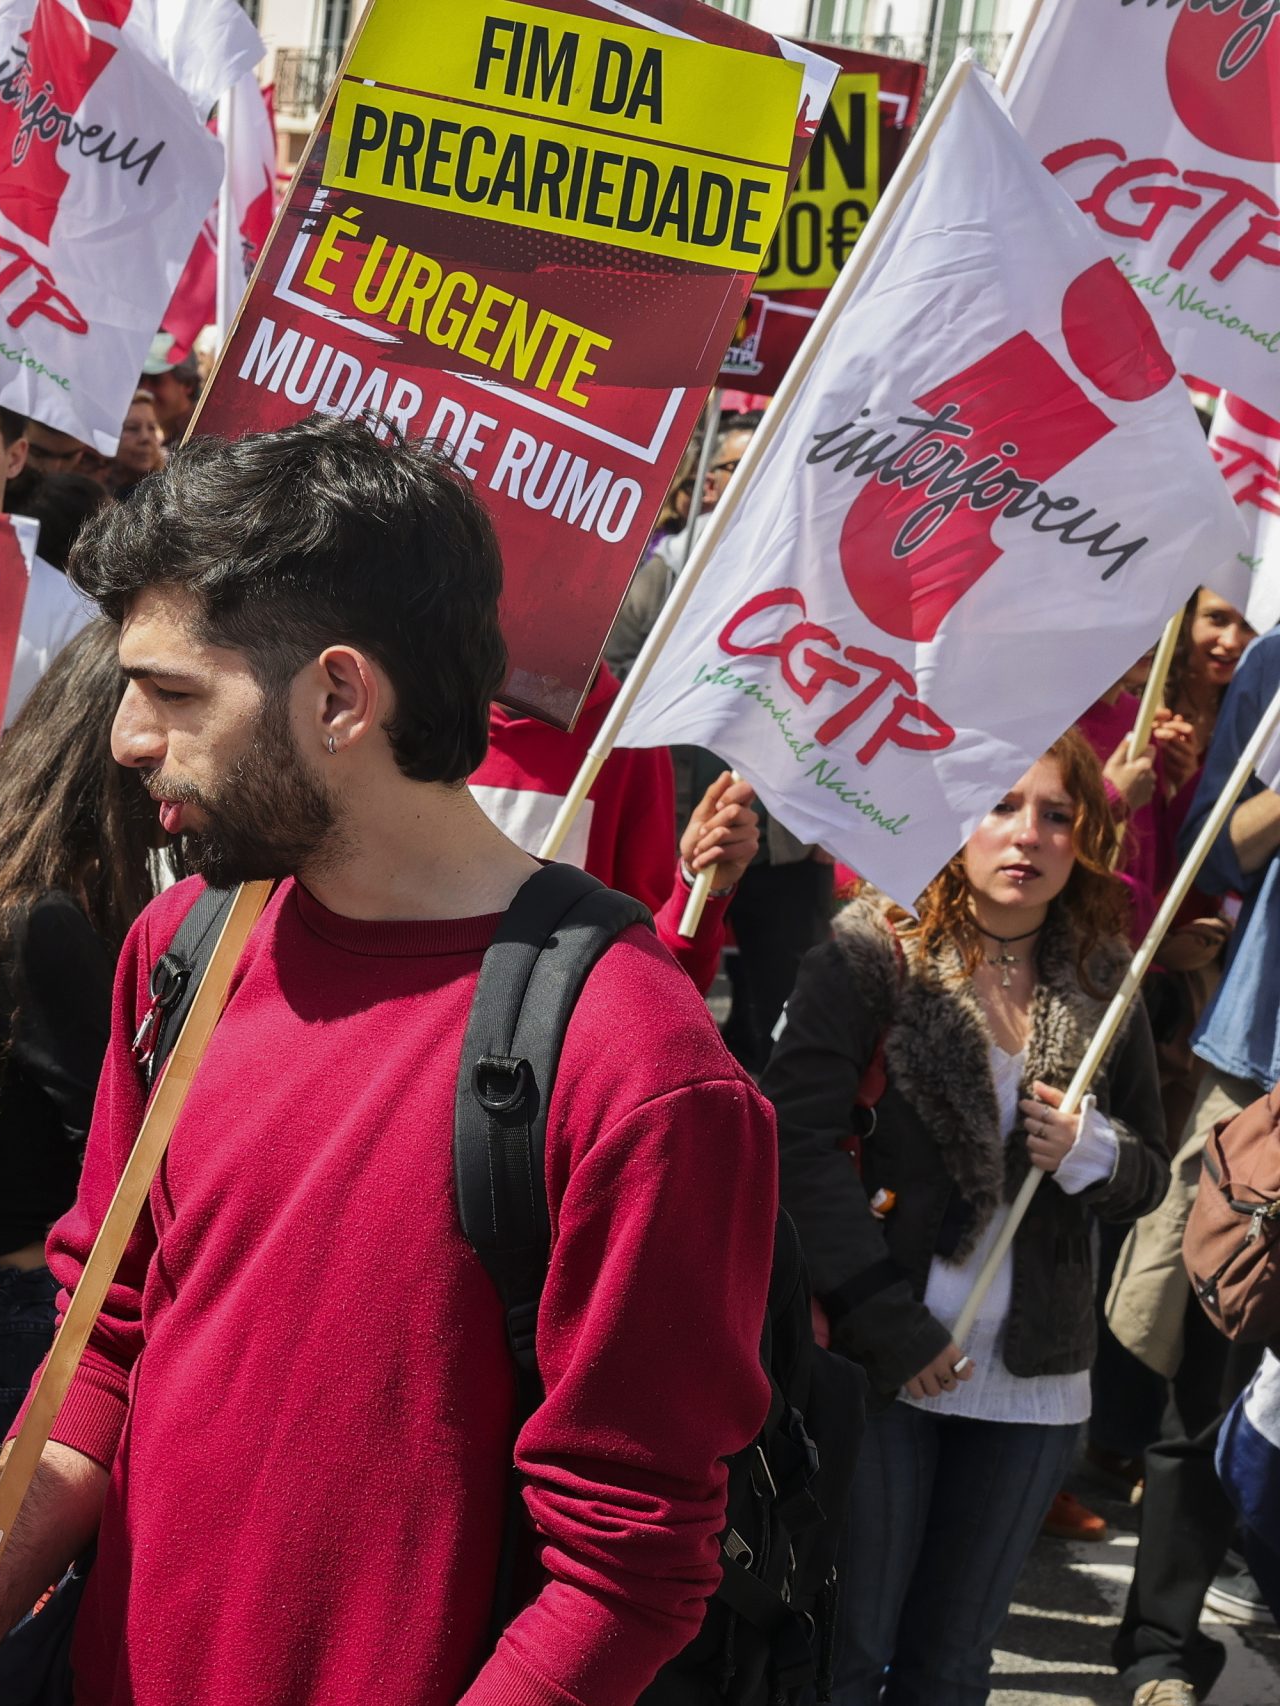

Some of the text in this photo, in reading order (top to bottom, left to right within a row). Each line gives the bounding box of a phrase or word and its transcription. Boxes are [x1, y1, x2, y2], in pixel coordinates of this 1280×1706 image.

[474, 15, 663, 125] FIM DA
[794, 92, 867, 191] N
[345, 103, 772, 255] PRECARIEDADE
[303, 206, 612, 408] É URGENTE
[238, 316, 642, 543] MUDAR DE RUMO
[717, 587, 956, 765] CGTP
[804, 758, 910, 835] Nacional
